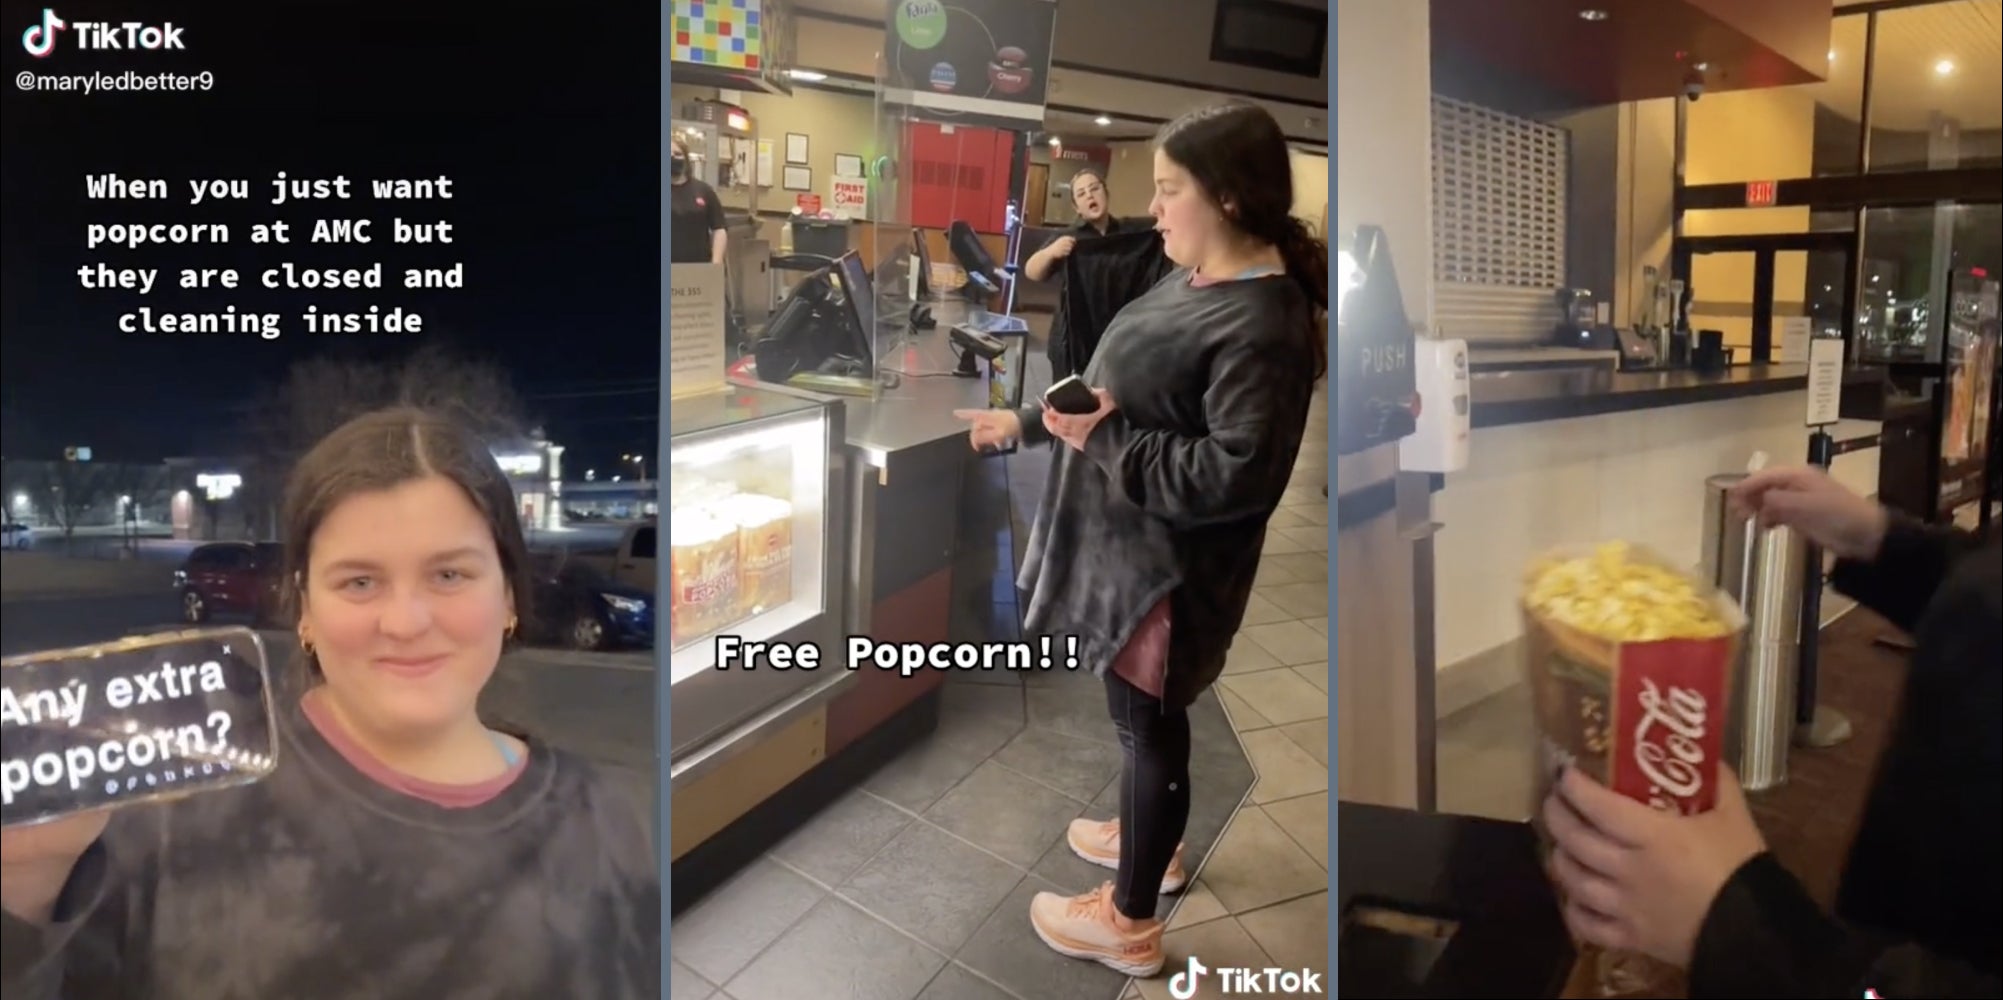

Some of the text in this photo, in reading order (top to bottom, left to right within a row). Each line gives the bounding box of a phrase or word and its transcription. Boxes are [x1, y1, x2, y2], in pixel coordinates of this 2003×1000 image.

[835, 182, 864, 193] FIRST
[846, 195, 864, 205] AID
[1749, 182, 1772, 202] EXIT
[1362, 346, 1406, 377] PUSH
[1, 659, 226, 727] Any extra
[1, 710, 232, 804] popcorn?
